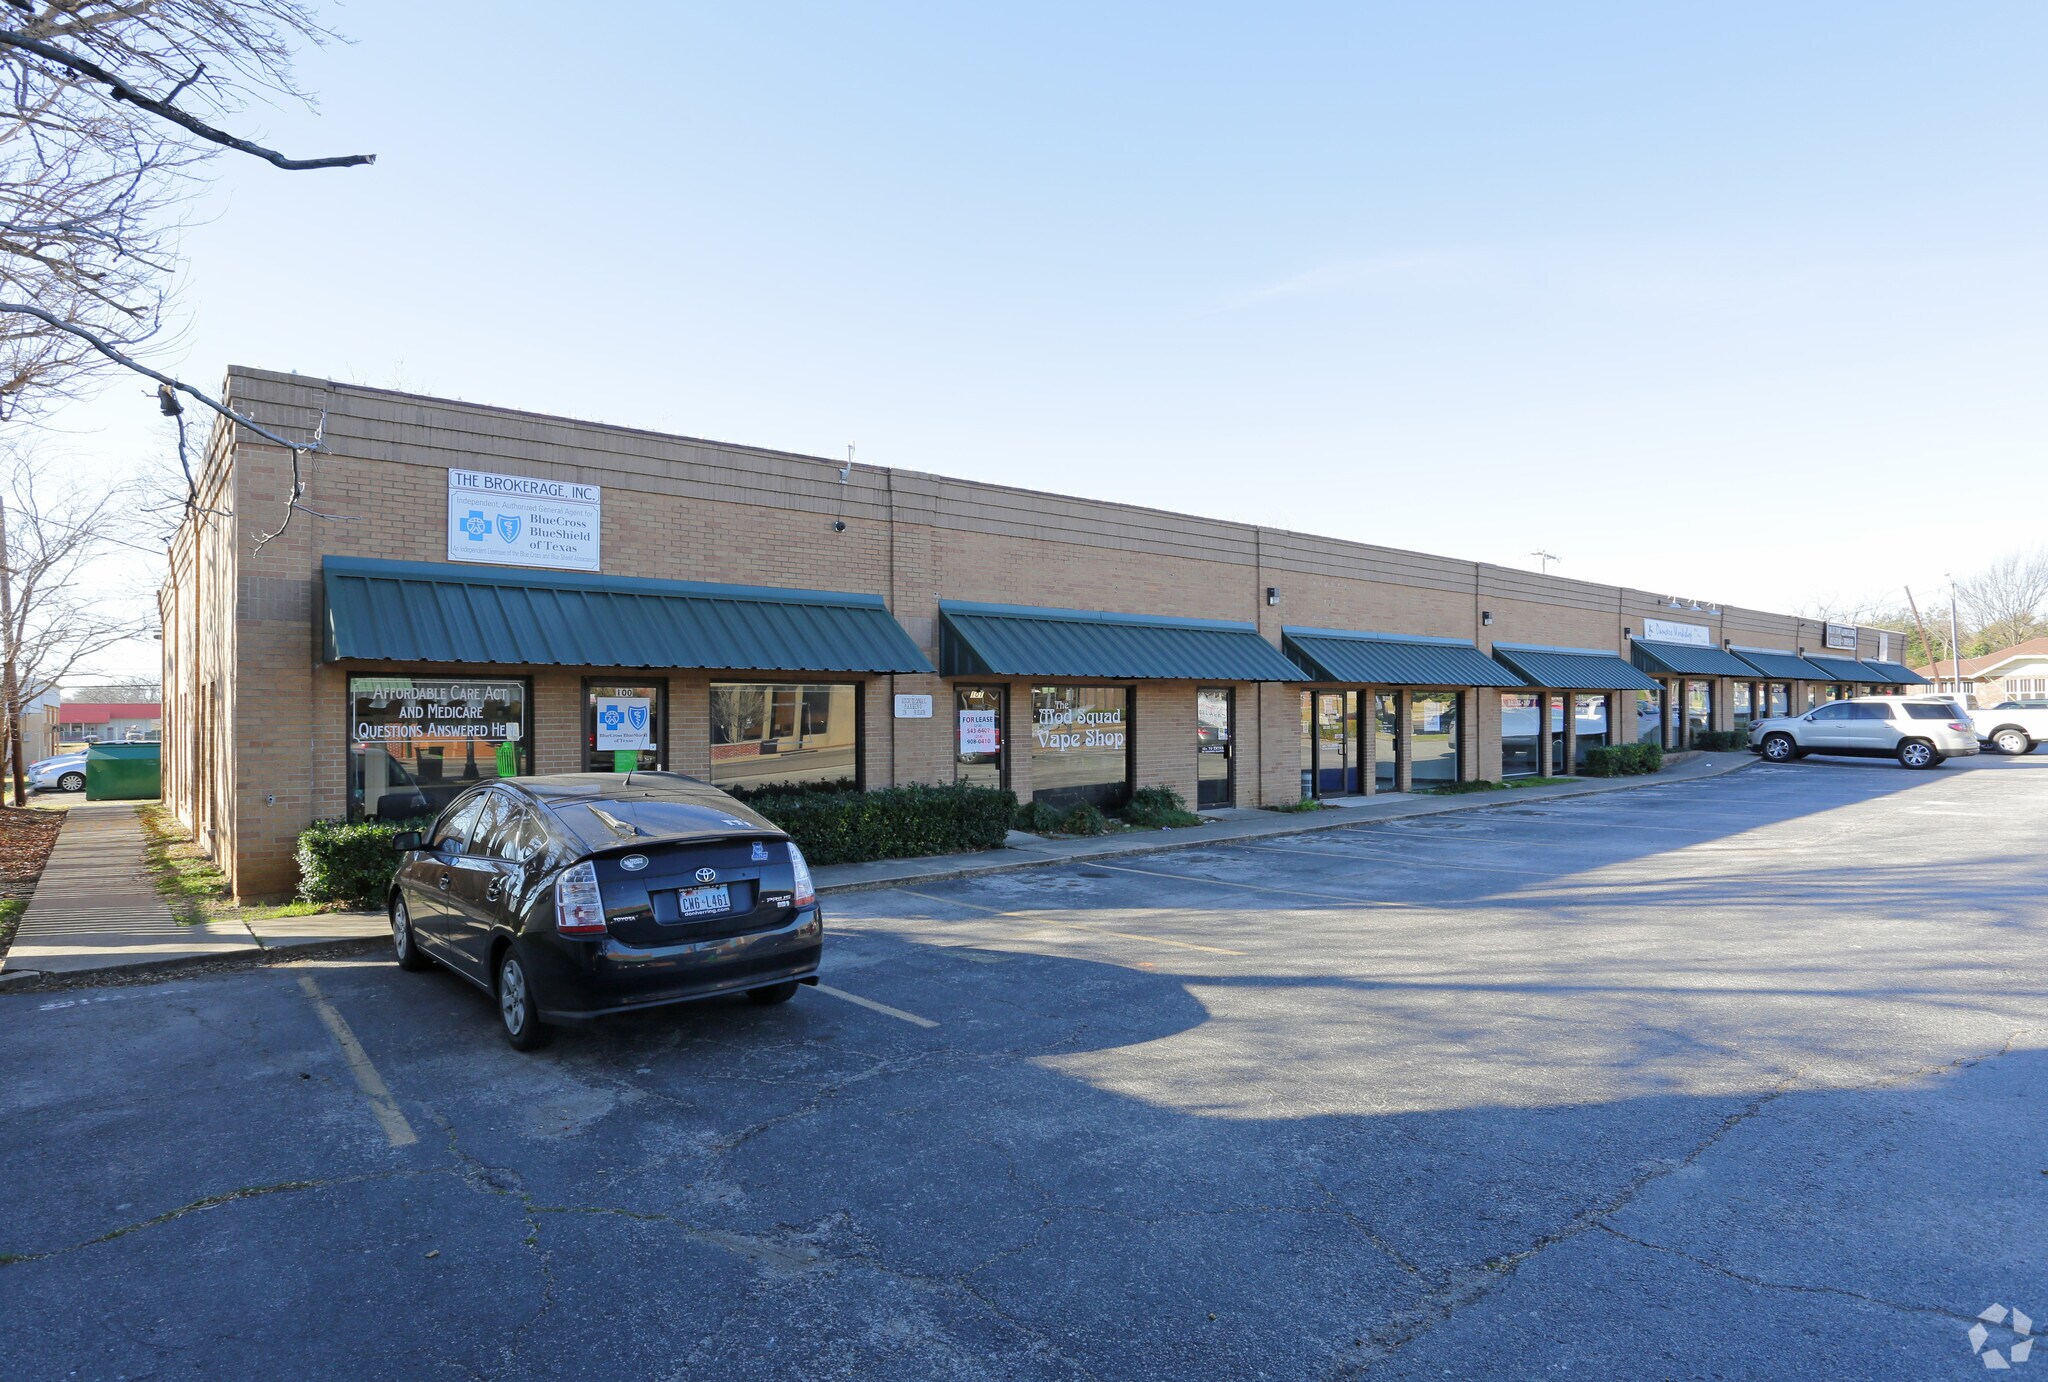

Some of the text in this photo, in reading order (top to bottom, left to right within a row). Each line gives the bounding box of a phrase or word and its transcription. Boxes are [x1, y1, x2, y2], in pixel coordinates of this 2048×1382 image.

[455, 472, 596, 501] THE BROKERAGE, INC.
[502, 501, 537, 512] Authorized
[538, 504, 563, 515] General
[564, 508, 583, 518] Agent
[584, 510, 594, 518] for
[530, 513, 587, 528] BlueCross
[530, 526, 590, 541] BlueShield
[529, 540, 578, 553] of Texas
[373, 684, 508, 700] AFFORDABLE CARE ACT
[617, 689, 633, 697] 100
[399, 704, 483, 719] AND MEDICARE
[1055, 700, 1069, 709] The
[1039, 708, 1121, 727] Mod Squad
[358, 722, 423, 739] QUESTIONS
[427, 722, 488, 738] ANSWERED
[1037, 729, 1124, 751] Vape Shop
